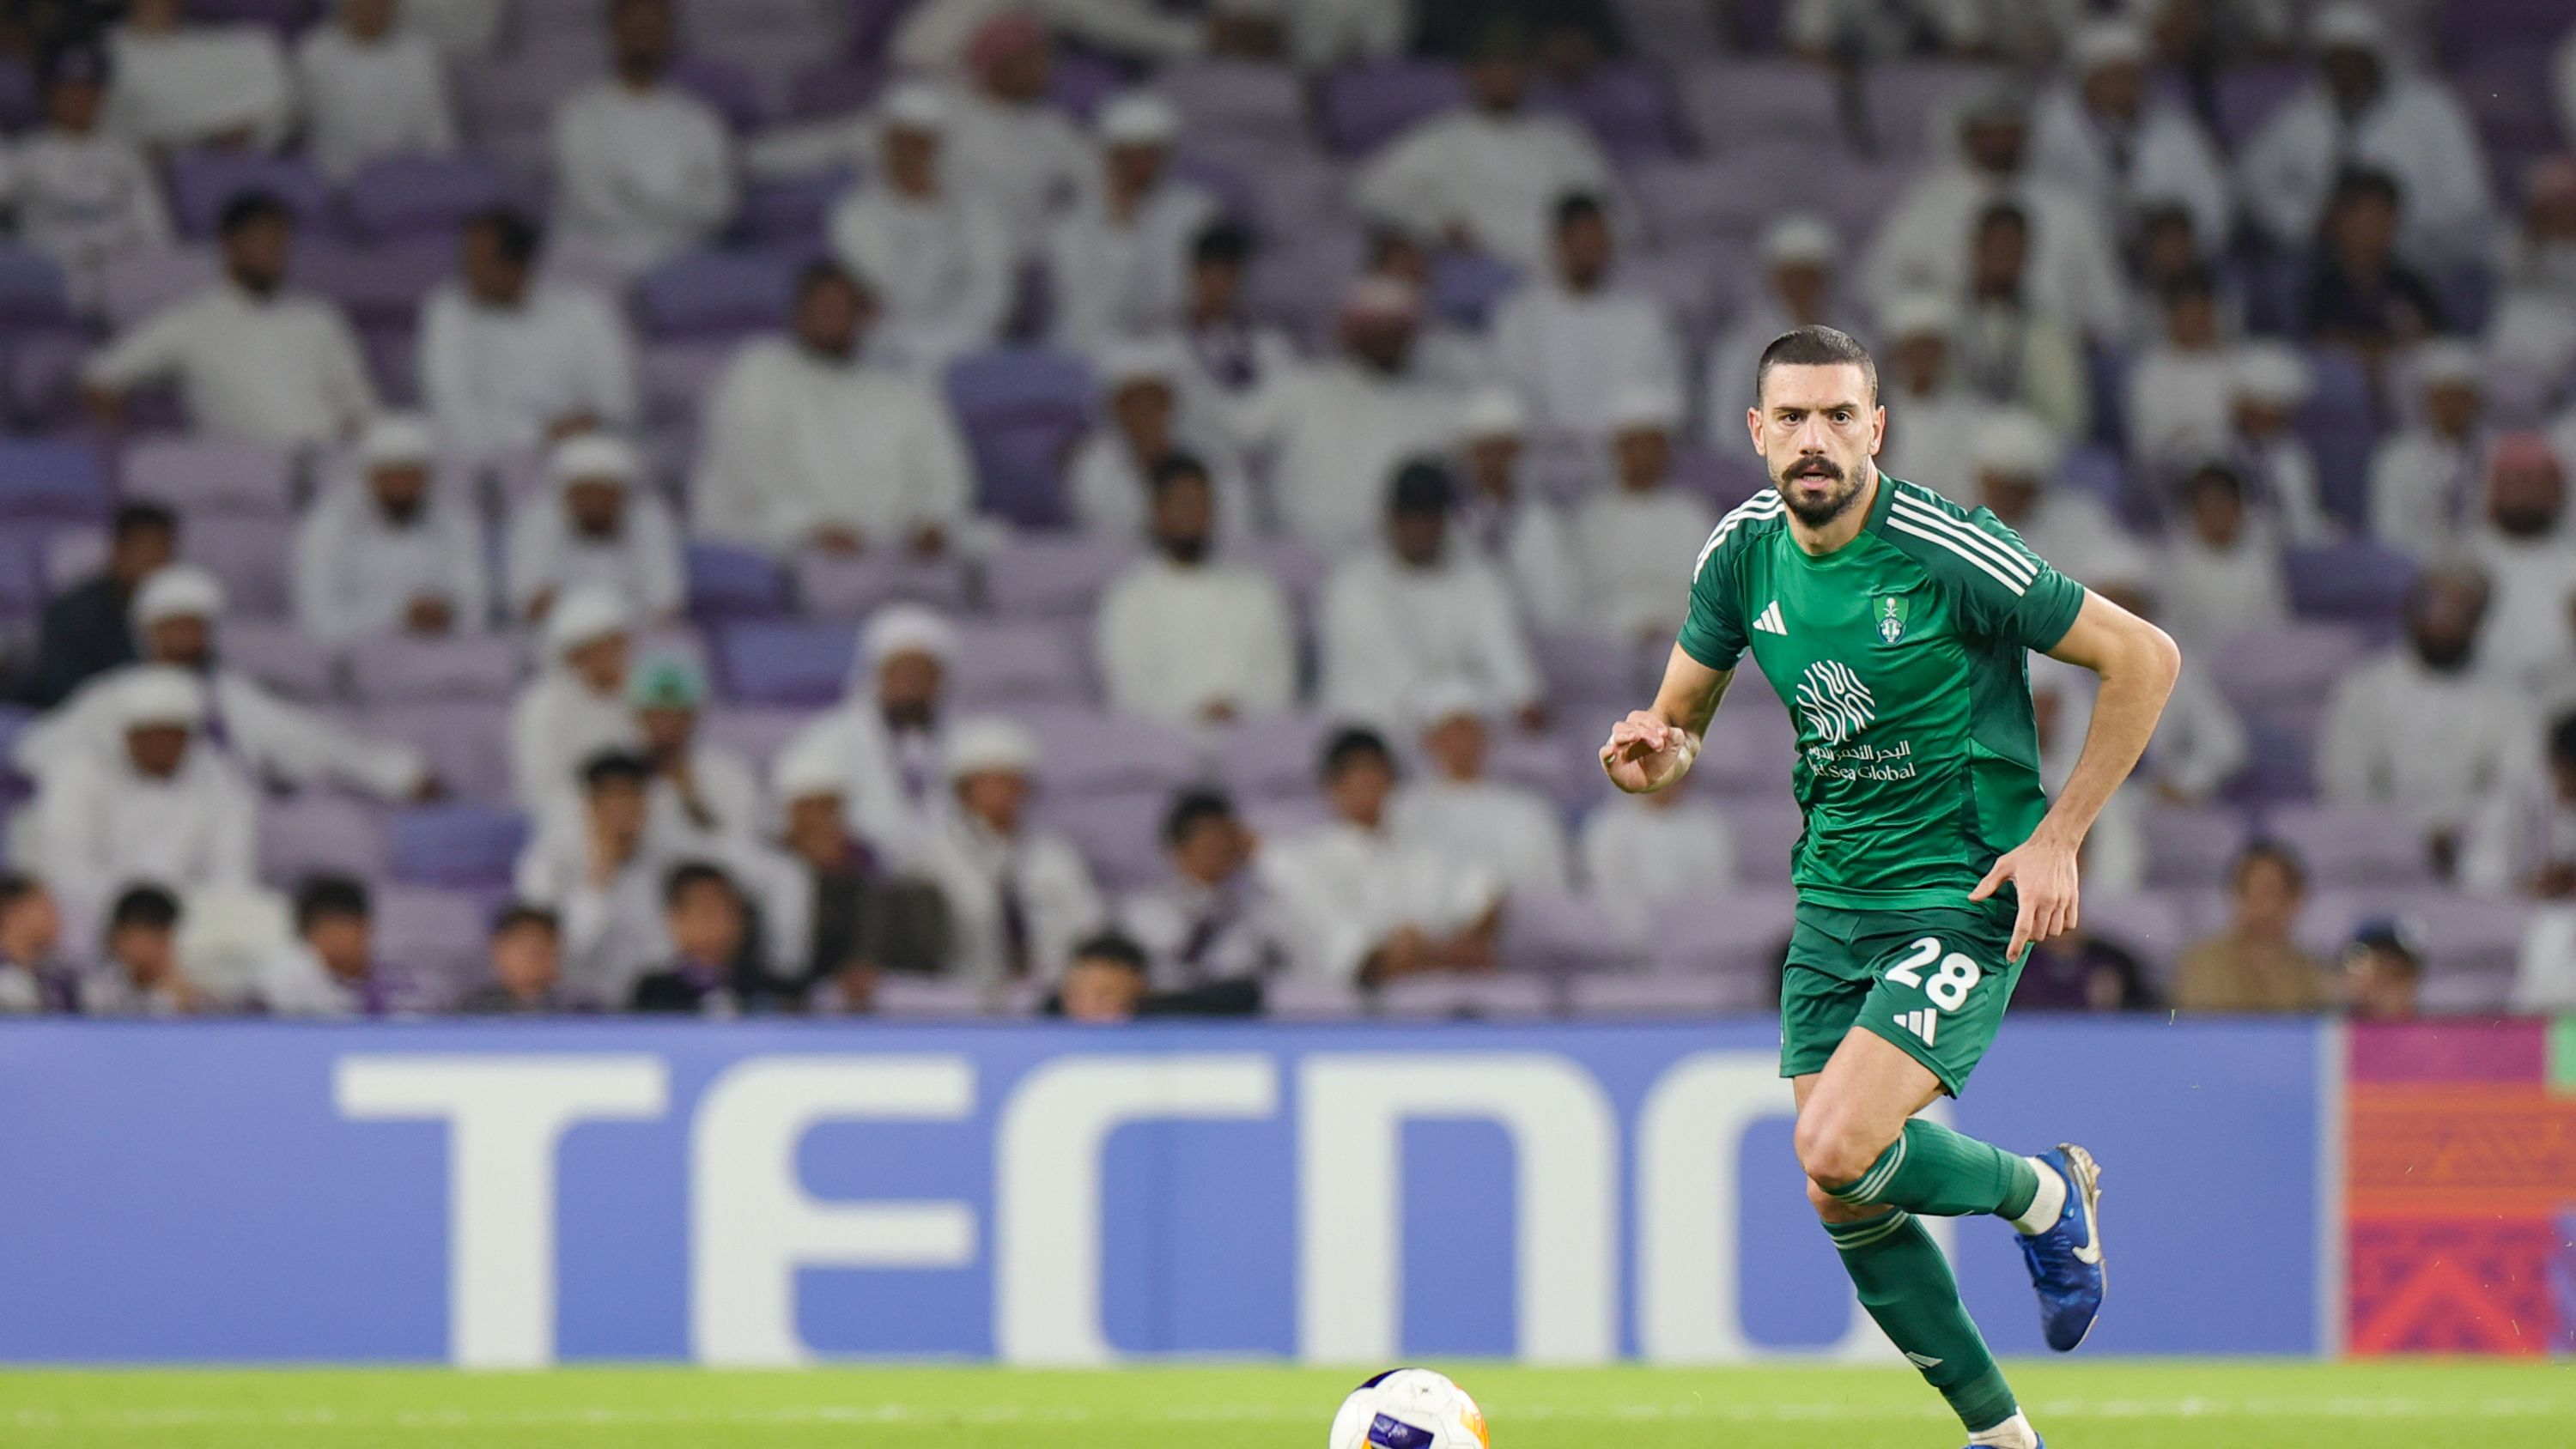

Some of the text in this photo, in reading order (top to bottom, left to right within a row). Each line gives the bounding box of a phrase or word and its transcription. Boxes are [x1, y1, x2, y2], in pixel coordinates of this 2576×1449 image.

[1828, 764, 1856, 781] Sea
[1857, 762, 1917, 782] Global
[1875, 740, 1911, 763] البحر
[1885, 937, 1981, 1012] 28
[335, 1054, 1958, 1368] TECNO
